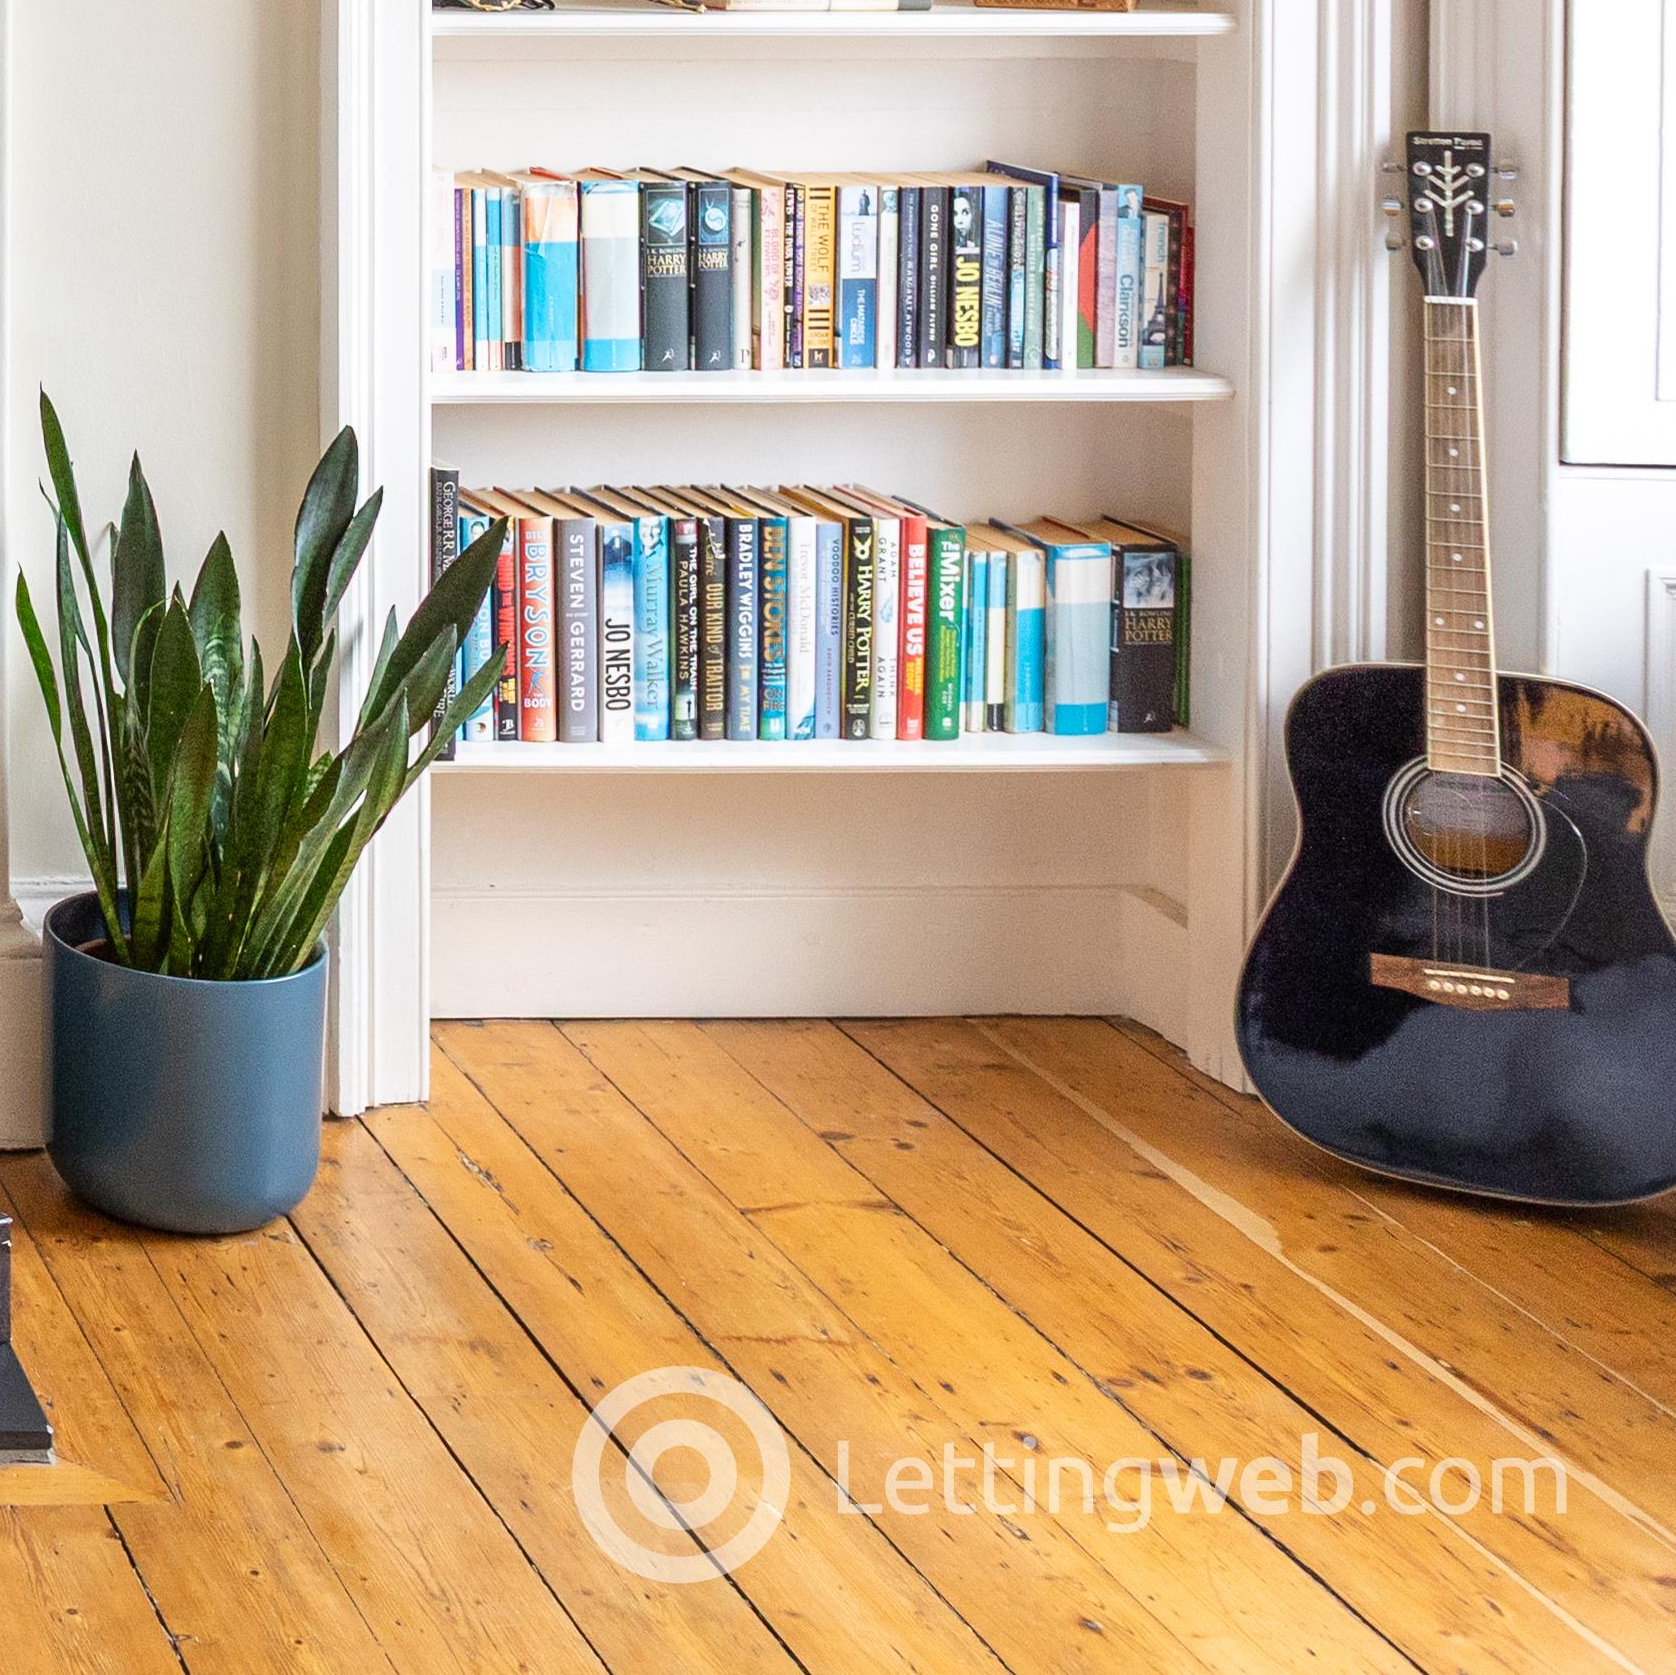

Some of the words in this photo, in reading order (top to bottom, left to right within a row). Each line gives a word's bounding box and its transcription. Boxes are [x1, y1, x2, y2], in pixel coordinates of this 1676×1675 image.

[810, 204, 817, 214] OF
[818, 204, 829, 232] THE
[931, 204, 939, 239] GONE
[699, 252, 728, 260] HARRY
[771, 228, 779, 261] BLOOD
[818, 235, 829, 273] WOLF
[851, 222, 865, 272] Ludlum
[930, 243, 939, 270] GIRL
[986, 220, 1004, 257] ALONE
[1157, 222, 1166, 263] french
[647, 254, 686, 265] HARRY
[647, 264, 686, 274] POTTER
[699, 259, 728, 268] POTTER
[955, 256, 980, 282] JO
[857, 289, 866, 303] THE
[985, 268, 1003, 306] BERLIN
[955, 286, 980, 347] NESBO
[1119, 274, 1134, 348] Clarkson
[442, 481, 455, 528] GEORGE
[739, 524, 753, 590] BRADLEY
[763, 526, 785, 571] BEN
[800, 542, 812, 580] Trevor
[878, 537, 887, 582] GRANT
[498, 555, 514, 591] MIND
[569, 534, 584, 608] STEVEN
[679, 560, 689, 607] PAULA
[907, 544, 925, 625] BELIEVE
[939, 551, 960, 621] Mixer
[524, 544, 549, 668] BRYSON
[641, 564, 663, 635] Murray
[706, 583, 723, 609] OUR
[831, 587, 839, 636] HISTORIES
[856, 564, 873, 625] HARRY
[605, 618, 630, 643] JO
[690, 607, 697, 622] ON
[706, 613, 723, 643] KIND
[739, 593, 753, 658] WIGGINS
[763, 576, 785, 662] STOKES
[799, 586, 812, 654] McDonald
[1125, 617, 1171, 630] HARRY
[679, 614, 689, 680] HAWKINS
[906, 627, 923, 656] US
[1125, 629, 1172, 641] POTTER
[570, 621, 585, 711] GERRARD
[646, 638, 664, 709] Walker
[690, 651, 698, 690] TRAIN
[855, 627, 873, 692] POTTER
[877, 657, 886, 698] AGAIN
[605, 649, 631, 711] NESBO
[706, 658, 724, 711] TRAITOR
[739, 685, 751, 702] MY
[524, 698, 552, 708] BODY
[739, 705, 751, 732] TIME
